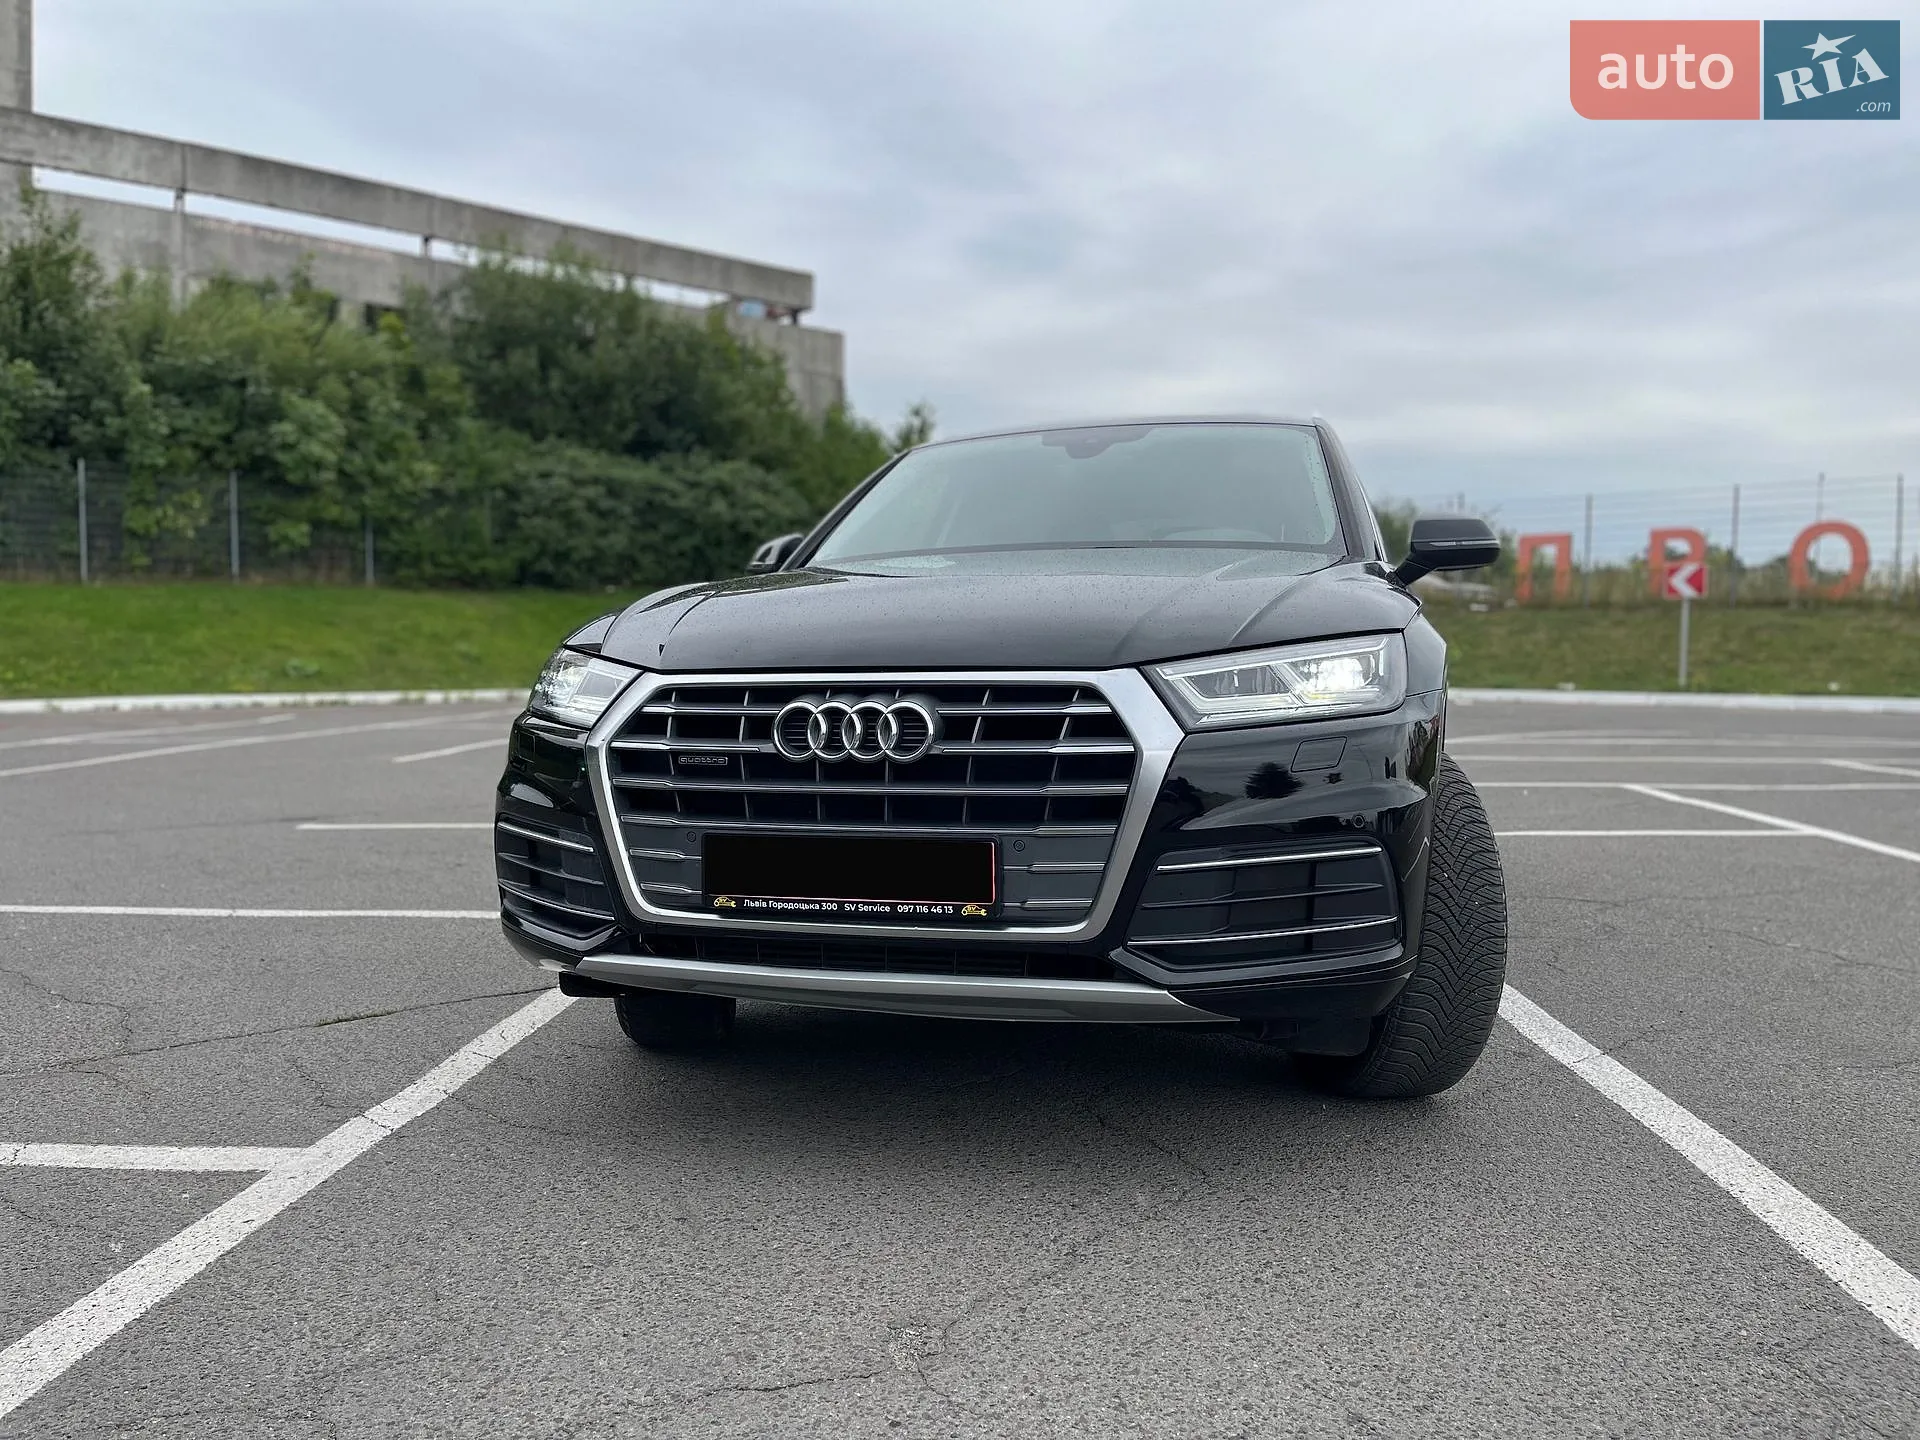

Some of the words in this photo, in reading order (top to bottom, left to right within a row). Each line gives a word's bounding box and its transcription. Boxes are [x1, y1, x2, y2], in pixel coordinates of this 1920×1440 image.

[680, 757, 725, 765] quattro
[744, 899, 767, 908] Львів
[769, 900, 819, 910] Городоцька
[821, 902, 837, 910] 300
[844, 903, 856, 911] SV
[858, 903, 891, 912] Service
[897, 904, 914, 913] 097
[916, 905, 929, 913] 116
[931, 905, 942, 913] 46
[944, 905, 953, 914] 13
